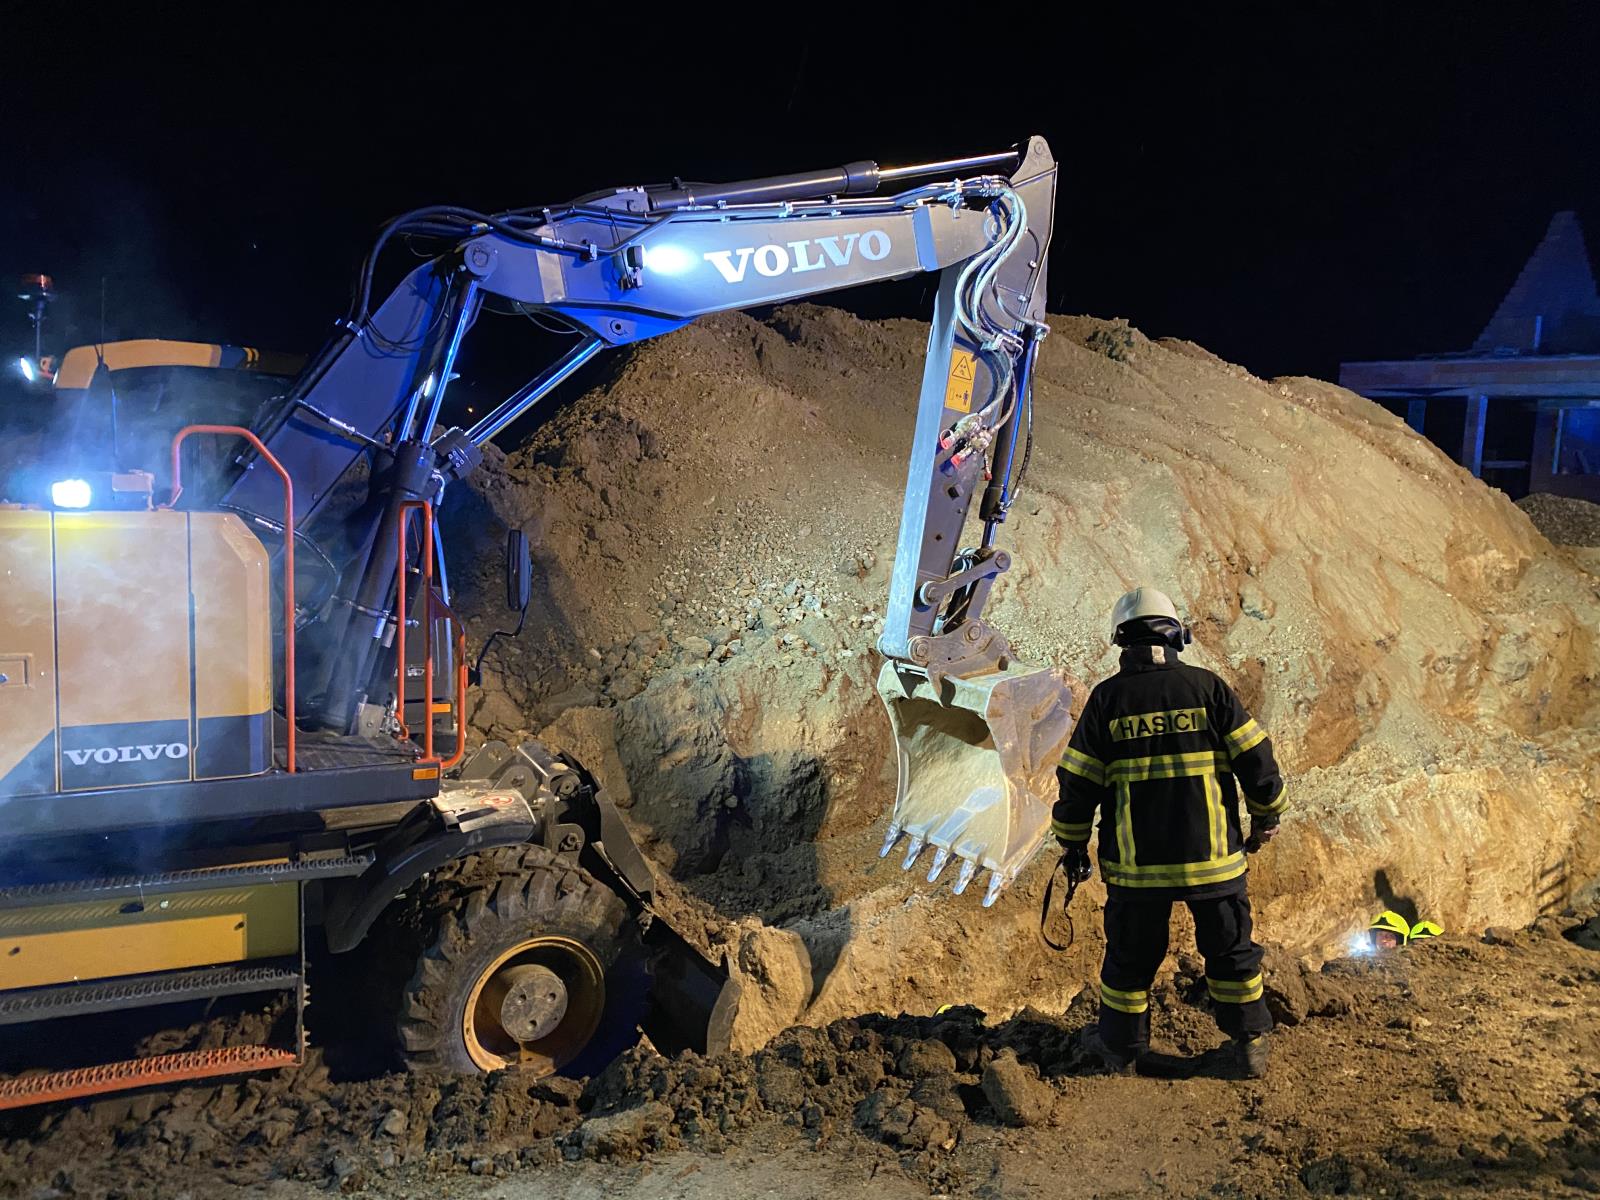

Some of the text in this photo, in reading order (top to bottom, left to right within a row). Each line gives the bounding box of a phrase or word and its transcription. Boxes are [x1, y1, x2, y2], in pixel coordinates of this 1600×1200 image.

[704, 230, 892, 283] VOLVO
[1120, 710, 1197, 738] HASIČI
[63, 743, 188, 766] VOLVO
